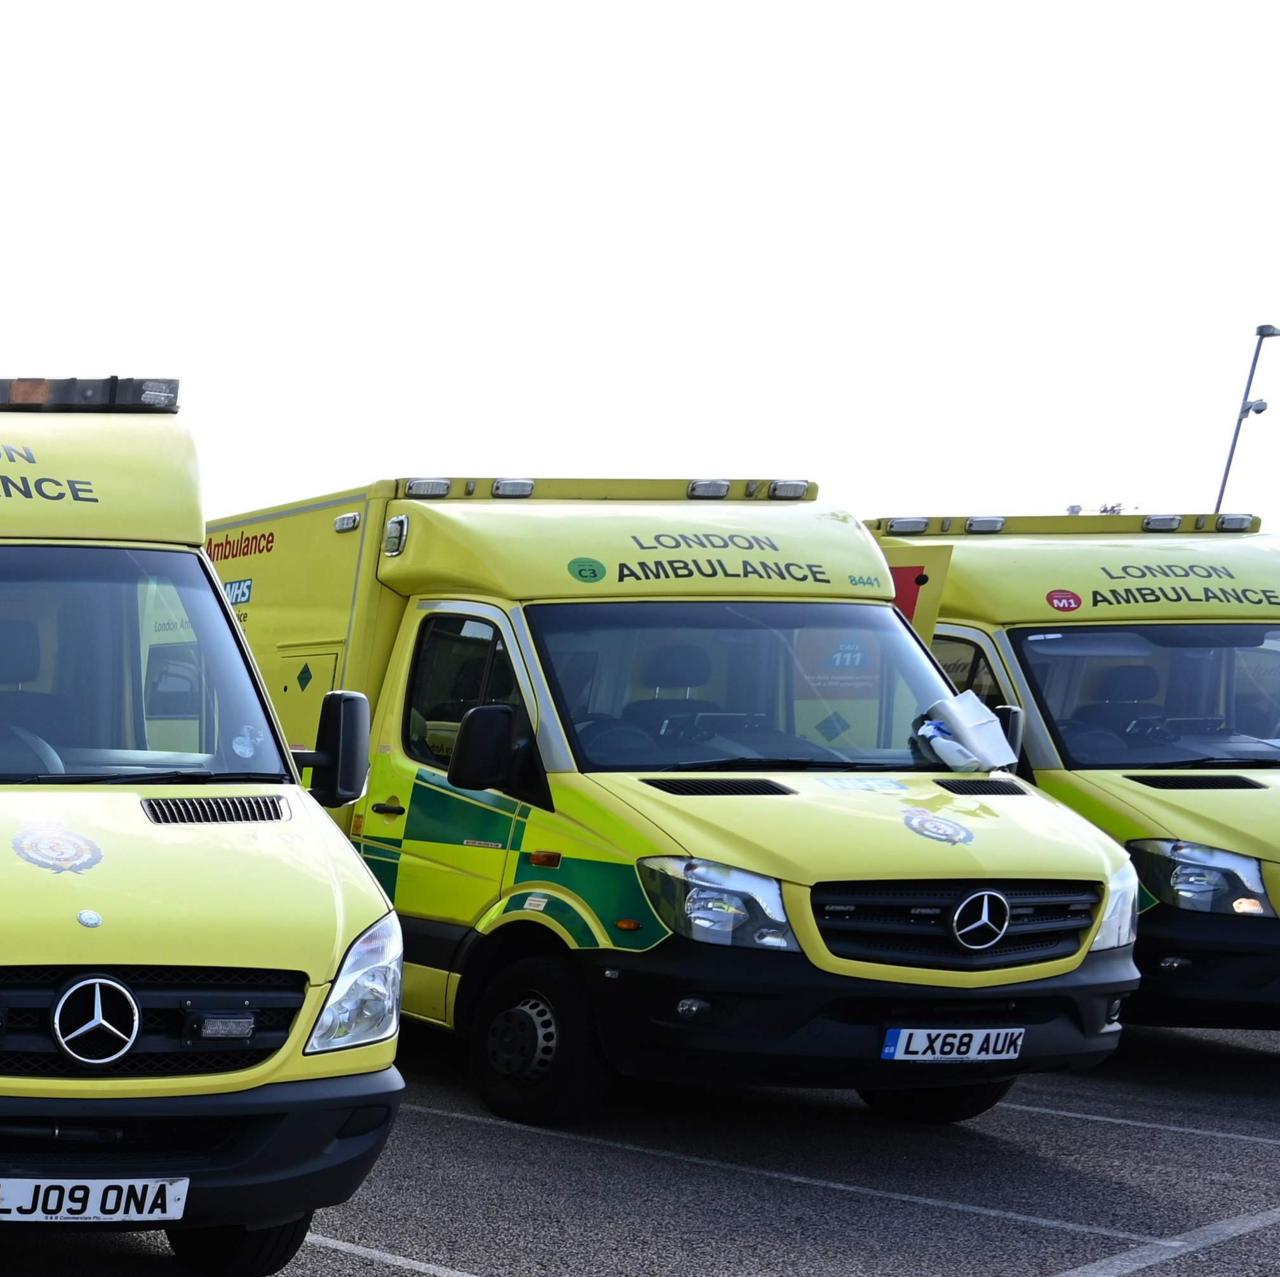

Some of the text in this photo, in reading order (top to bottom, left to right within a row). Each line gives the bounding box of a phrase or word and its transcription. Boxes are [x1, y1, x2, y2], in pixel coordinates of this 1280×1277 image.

[206, 530, 275, 562] Ambulance
[631, 534, 780, 551] LONDON
[578, 566, 598, 579] C3
[617, 558, 832, 584] AMBULANCE
[1100, 565, 1236, 580] LONDON
[848, 574, 881, 588] 8441
[1052, 599, 1078, 608] M1
[1092, 586, 1280, 607] AMBULANCE
[904, 1032, 1023, 1056] LX68 AUK
[99, 1183, 168, 1215] ONA
